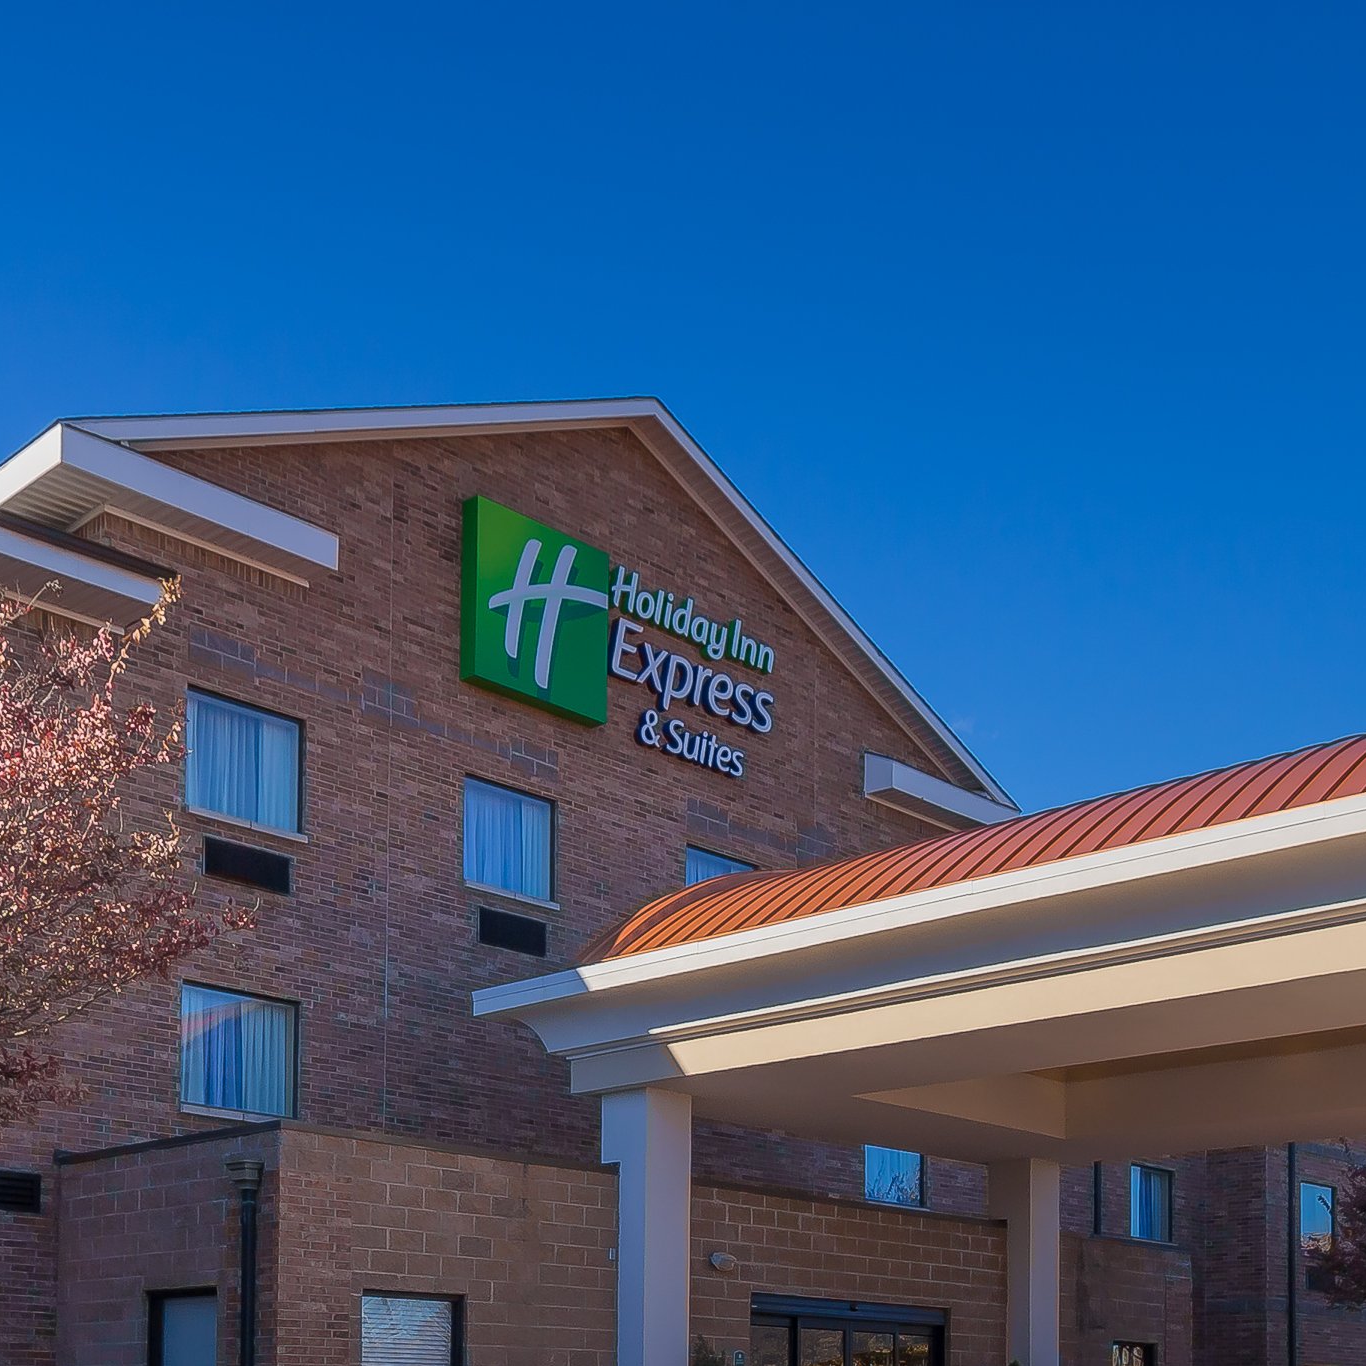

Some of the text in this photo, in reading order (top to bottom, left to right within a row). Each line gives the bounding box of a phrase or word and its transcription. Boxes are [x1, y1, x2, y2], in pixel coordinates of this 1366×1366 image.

[611, 564, 775, 674] Holiday Inn
[611, 617, 774, 733] Express
[640, 709, 745, 777] & Suites
